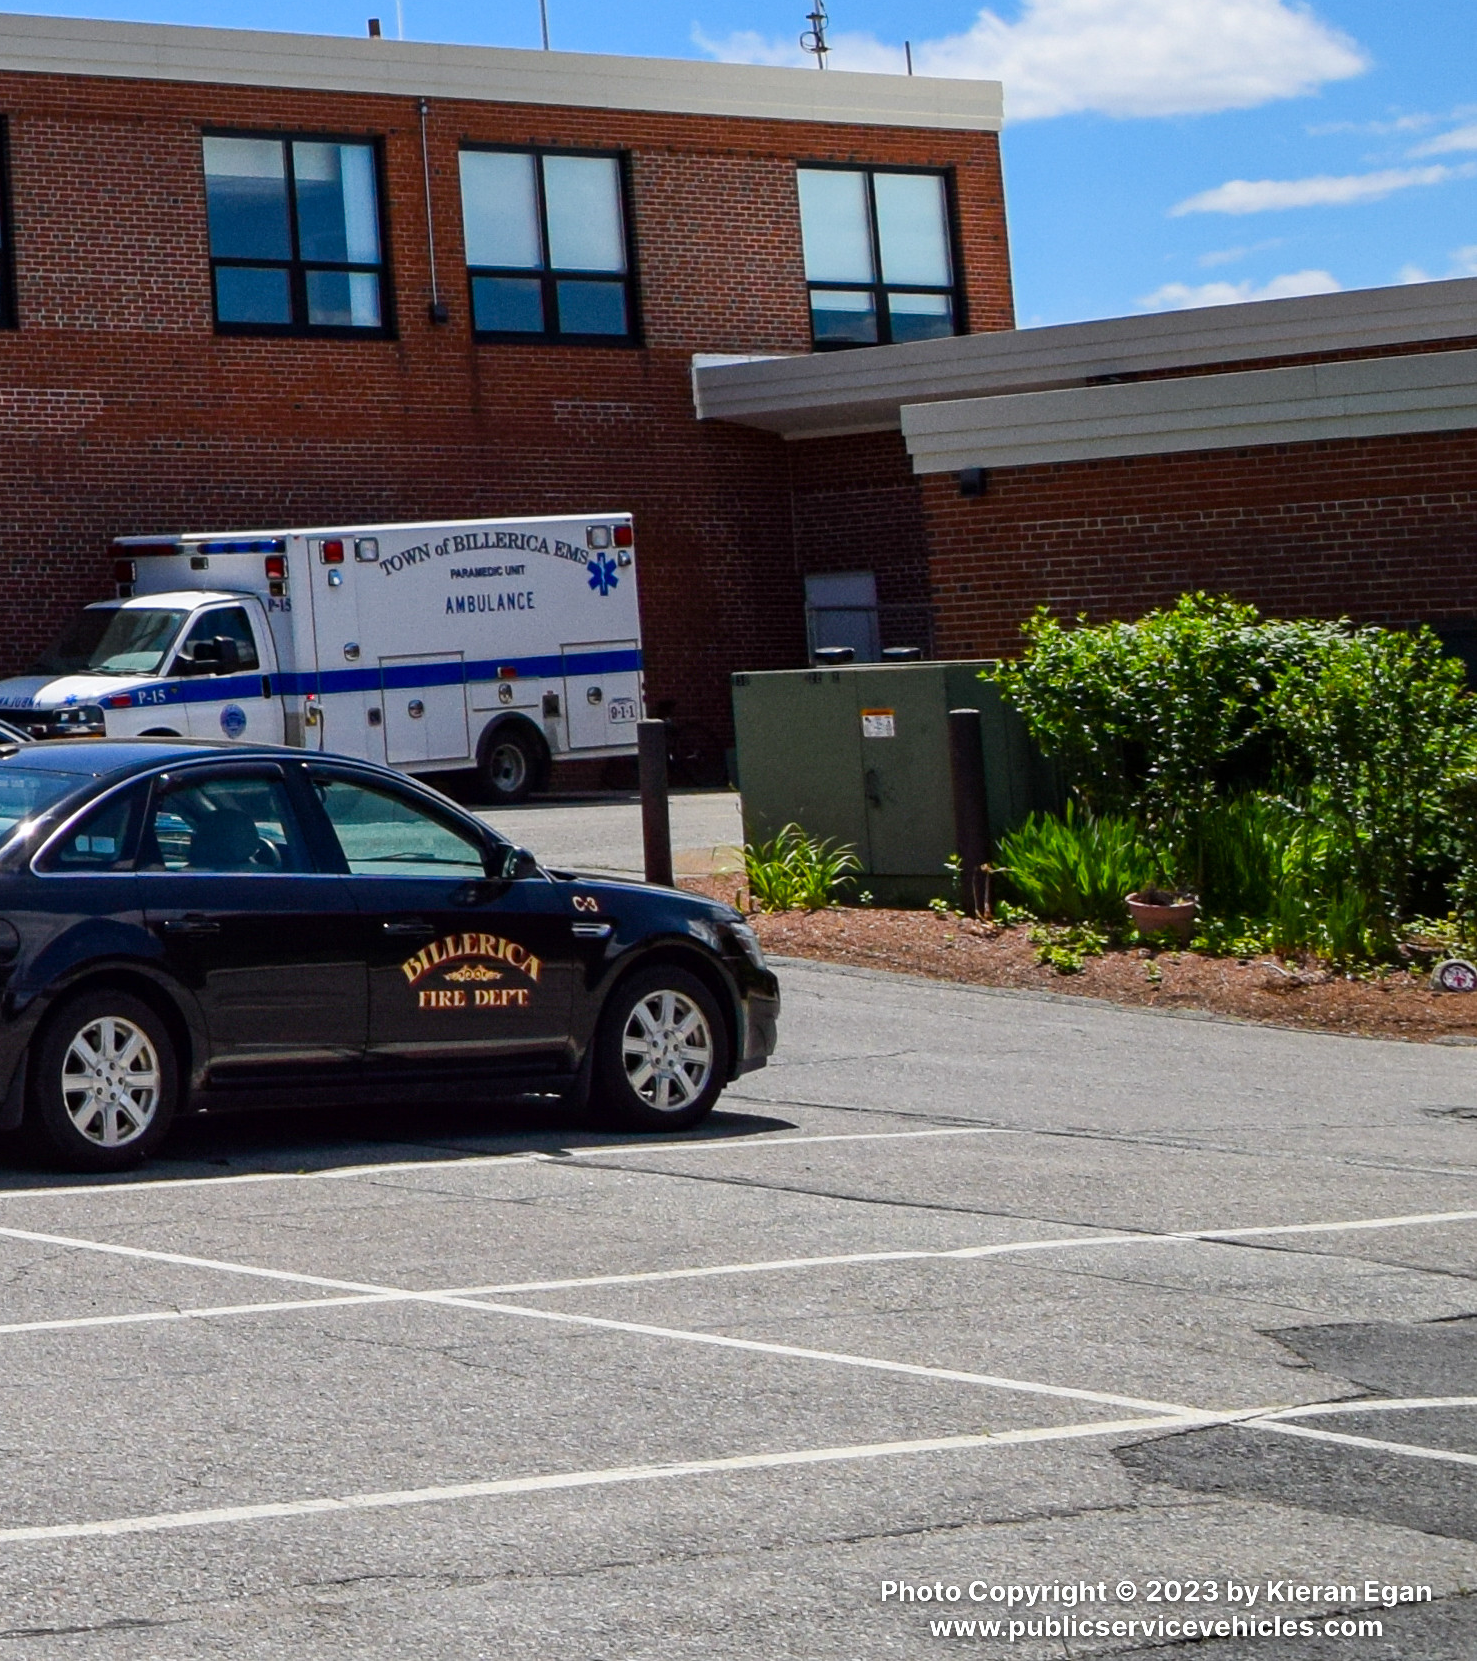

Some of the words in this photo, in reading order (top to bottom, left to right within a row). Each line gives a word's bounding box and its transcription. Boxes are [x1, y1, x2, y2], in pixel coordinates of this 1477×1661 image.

[379, 543, 431, 576] TOWN
[435, 538, 450, 556] of
[453, 532, 550, 554] BILLERICA
[554, 540, 589, 565] EMS
[450, 566, 503, 579] PARAMEDIC
[505, 565, 525, 576] UNIT
[268, 598, 292, 612] P-15
[445, 591, 535, 615] AMBULANCE
[138, 689, 166, 705] P-15
[572, 895, 599, 912] C-3
[401, 933, 543, 985] BILLERICA
[419, 990, 466, 1009] FIRE
